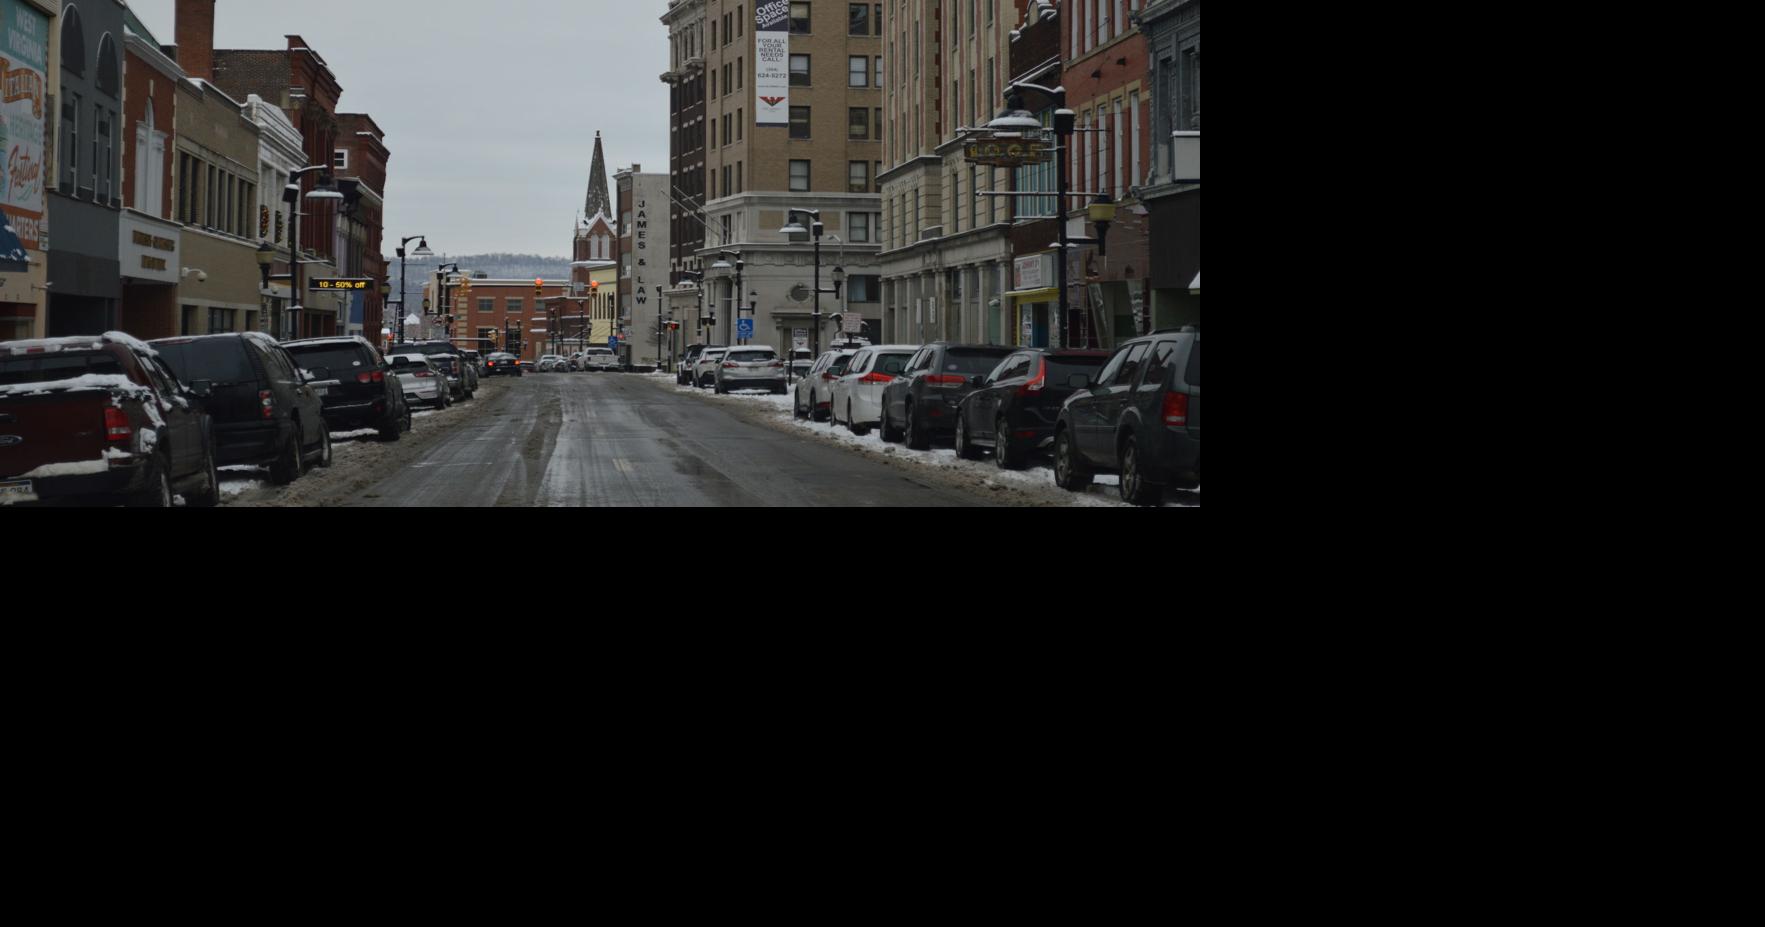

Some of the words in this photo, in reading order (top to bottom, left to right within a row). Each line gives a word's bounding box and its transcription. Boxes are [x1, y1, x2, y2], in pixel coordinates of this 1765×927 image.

[16, 5, 36, 35] WEST
[755, 5, 788, 25] Space
[756, 0, 789, 17] Office
[8, 27, 42, 65] VIRGINIA
[637, 200, 647, 249] JAMES
[638, 258, 647, 266] &
[354, 281, 366, 289] off
[636, 276, 647, 305] LAW
